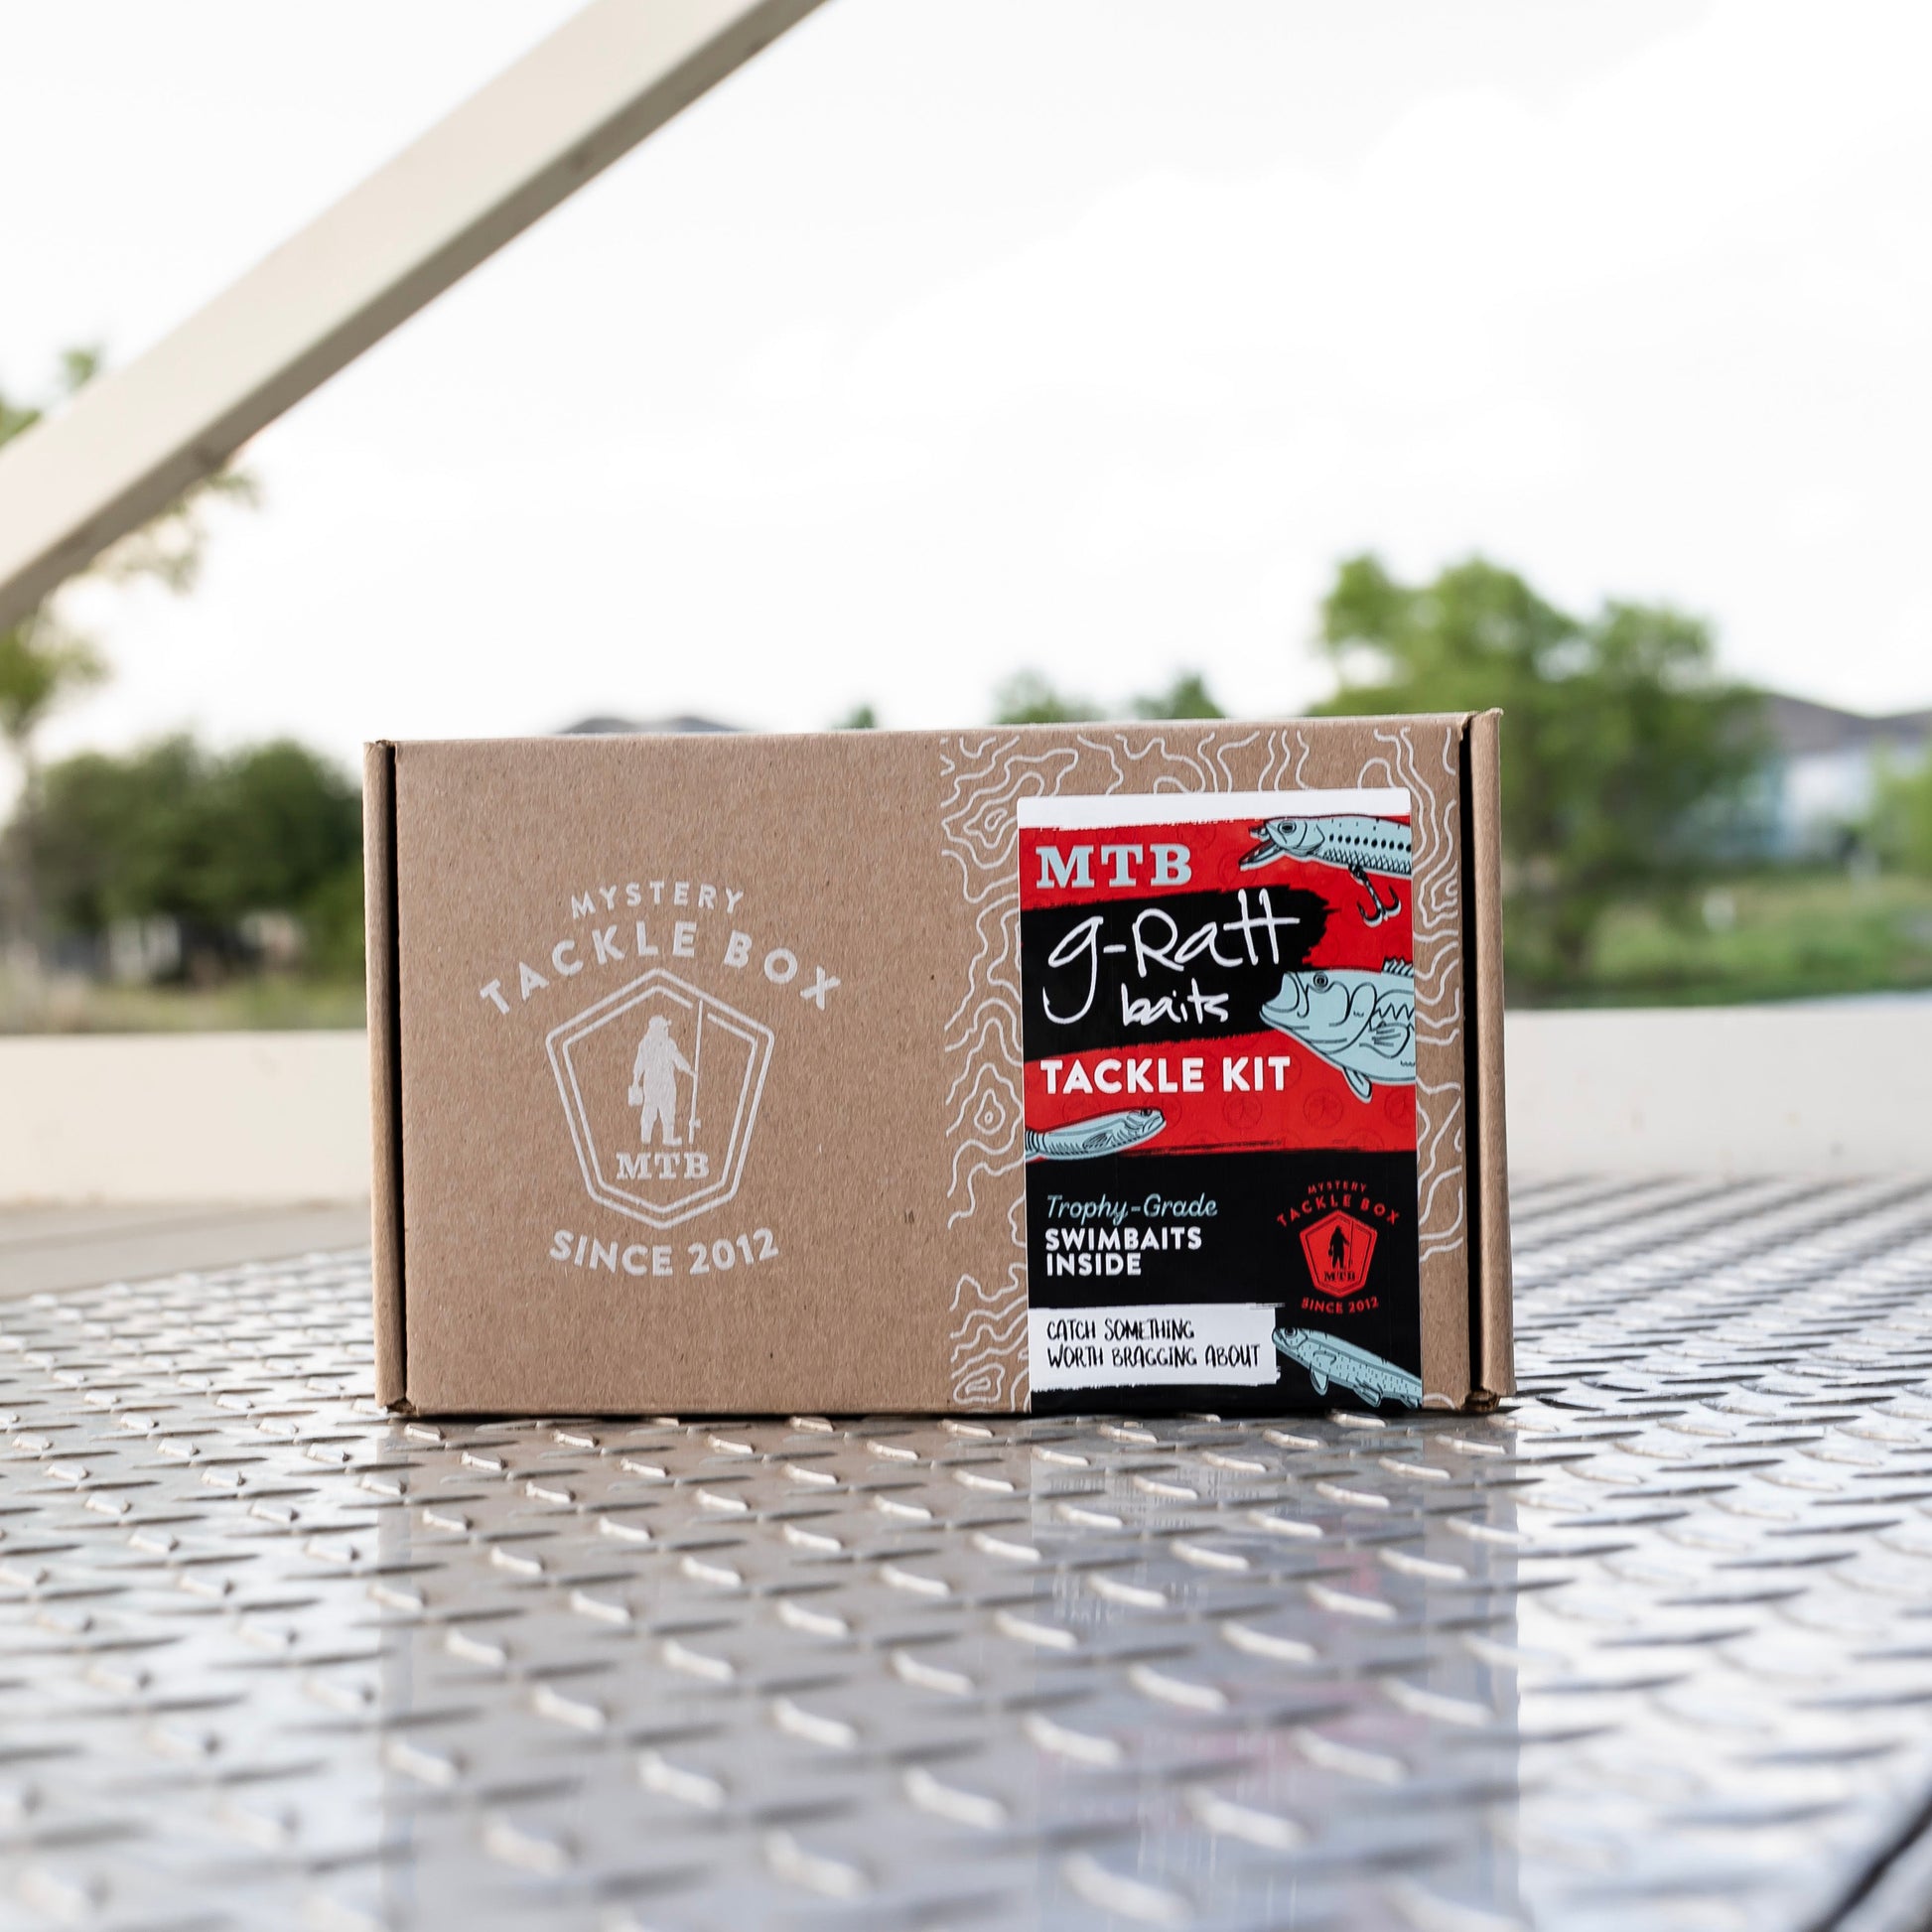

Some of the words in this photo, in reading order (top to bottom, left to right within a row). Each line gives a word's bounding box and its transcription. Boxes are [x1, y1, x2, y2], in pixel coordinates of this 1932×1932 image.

[1035, 843, 1191, 889] MTB
[571, 881, 744, 918] MYSTERY
[480, 920, 697, 1015] TACKLE
[724, 930, 841, 1010] BOX
[1121, 979, 1229, 1027] baits
[1040, 1057, 1204, 1094] TACKLE
[1222, 1056, 1291, 1091] KIT
[617, 1153, 710, 1179] MTB
[1308, 1179, 1367, 1194] MYSTERY
[1046, 1192, 1218, 1225] Trophy-Grade
[1277, 1195, 1351, 1227] TACKLE
[1360, 1196, 1400, 1225] BOX
[549, 1230, 673, 1276] SINCE
[689, 1227, 779, 1275] 2012
[1044, 1226, 1202, 1251] SWIMBAITS
[1046, 1253, 1142, 1277] INSIDE
[1323, 1271, 1355, 1283] MTB
[1301, 1297, 1343, 1314] SINCE
[1348, 1296, 1380, 1314] 2012
[1046, 1318, 1096, 1342] CATCH
[1104, 1317, 1195, 1341] SOMETHING
[1047, 1344, 1103, 1368] WORTH
[1112, 1343, 1197, 1367] BRAGGING
[1204, 1343, 1261, 1367] ABOUT
